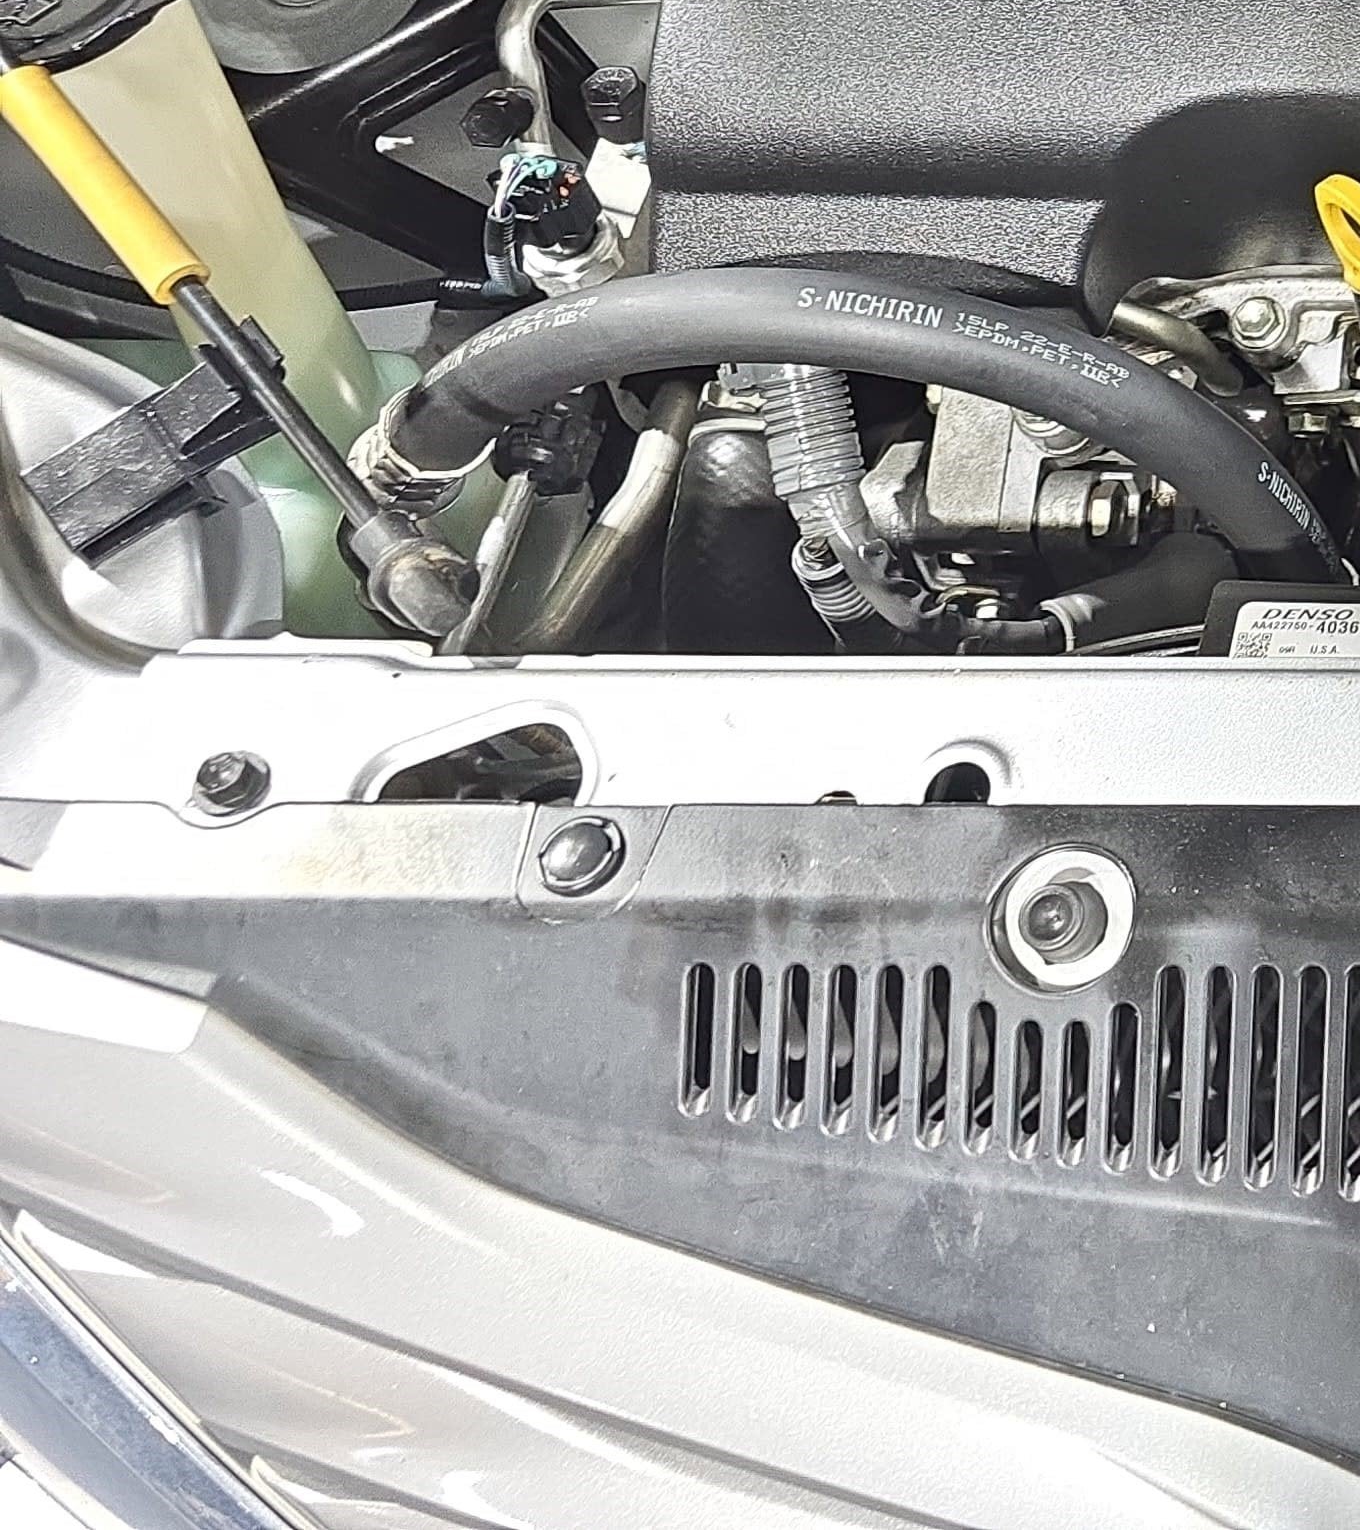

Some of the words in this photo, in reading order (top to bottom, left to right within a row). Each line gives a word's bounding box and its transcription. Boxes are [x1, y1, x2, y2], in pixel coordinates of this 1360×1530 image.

[797, 286, 943, 328] S-NICHIRIN
[957, 312, 1009, 331] 15LP
[1262, 608, 1354, 620] DENSO
[1310, 645, 1340, 654] U.S.A.
